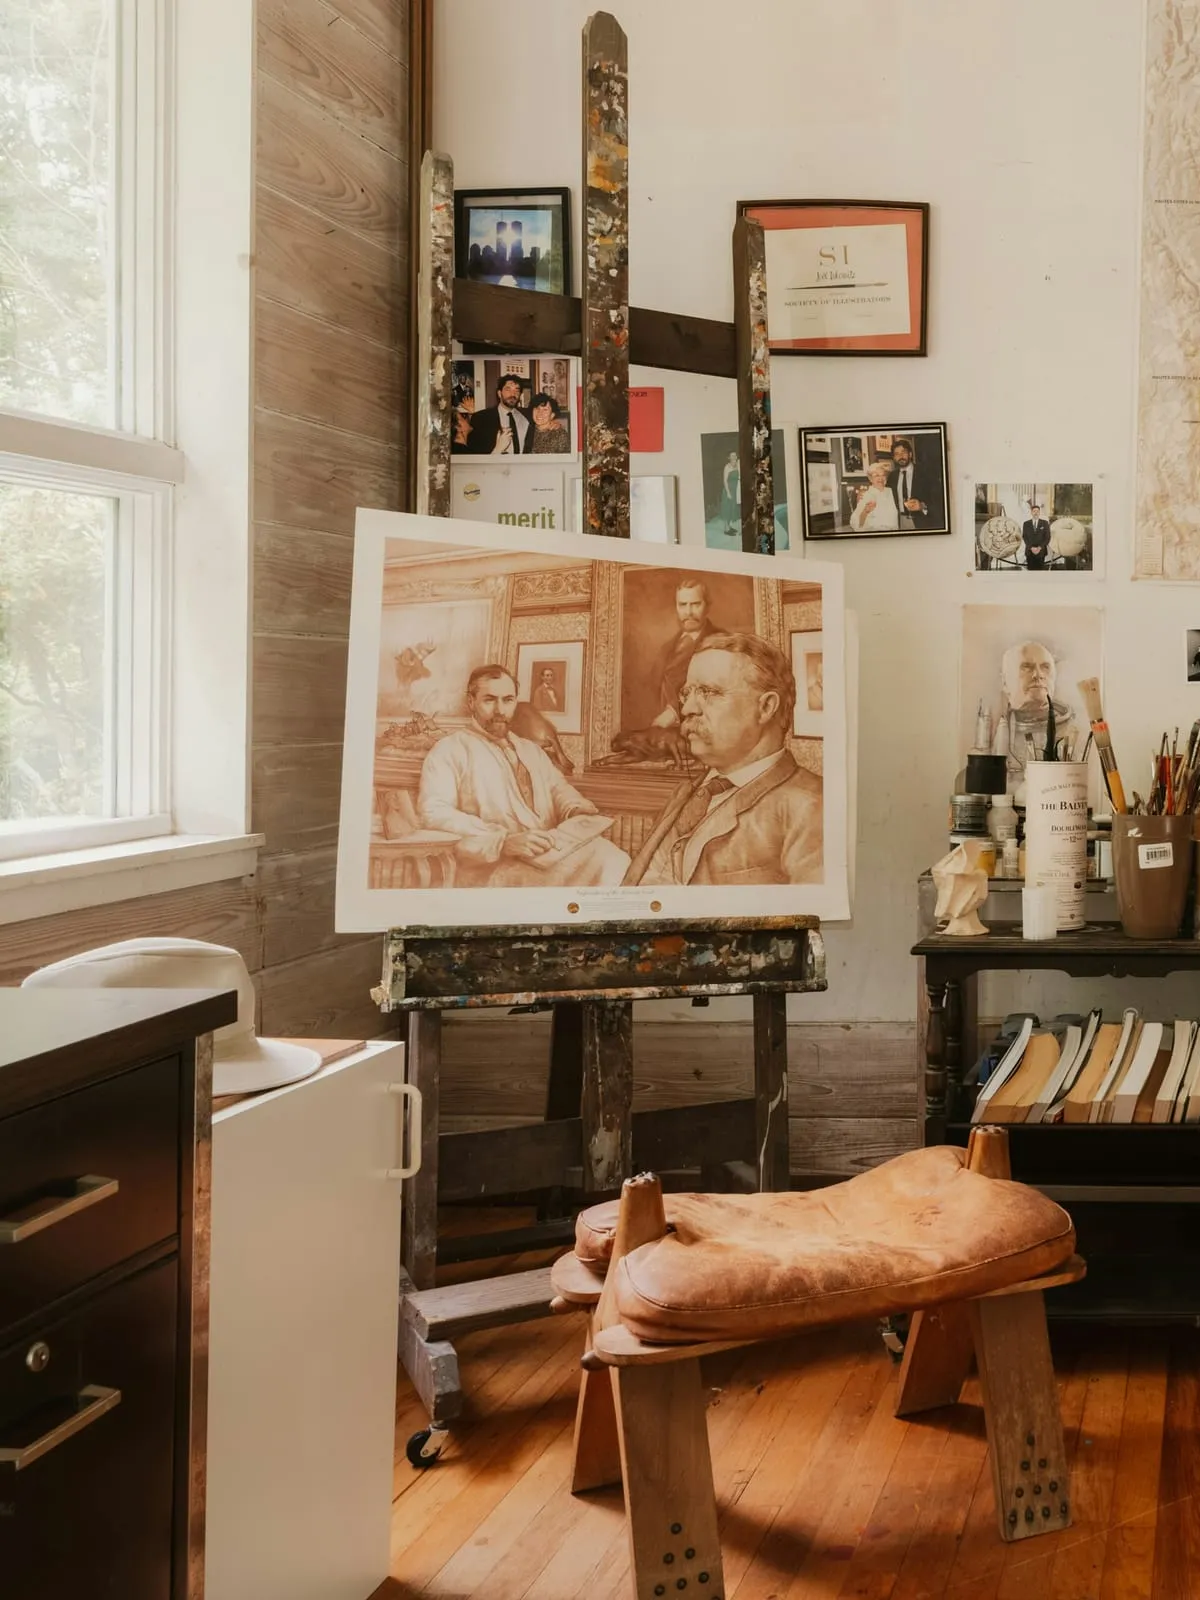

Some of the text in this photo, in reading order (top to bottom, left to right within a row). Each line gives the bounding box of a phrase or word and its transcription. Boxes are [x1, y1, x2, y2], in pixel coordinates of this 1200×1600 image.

[784, 299, 818, 307] SOCIETY
[832, 296, 891, 305] ILLUSTRATORS
[498, 506, 555, 529] merit
